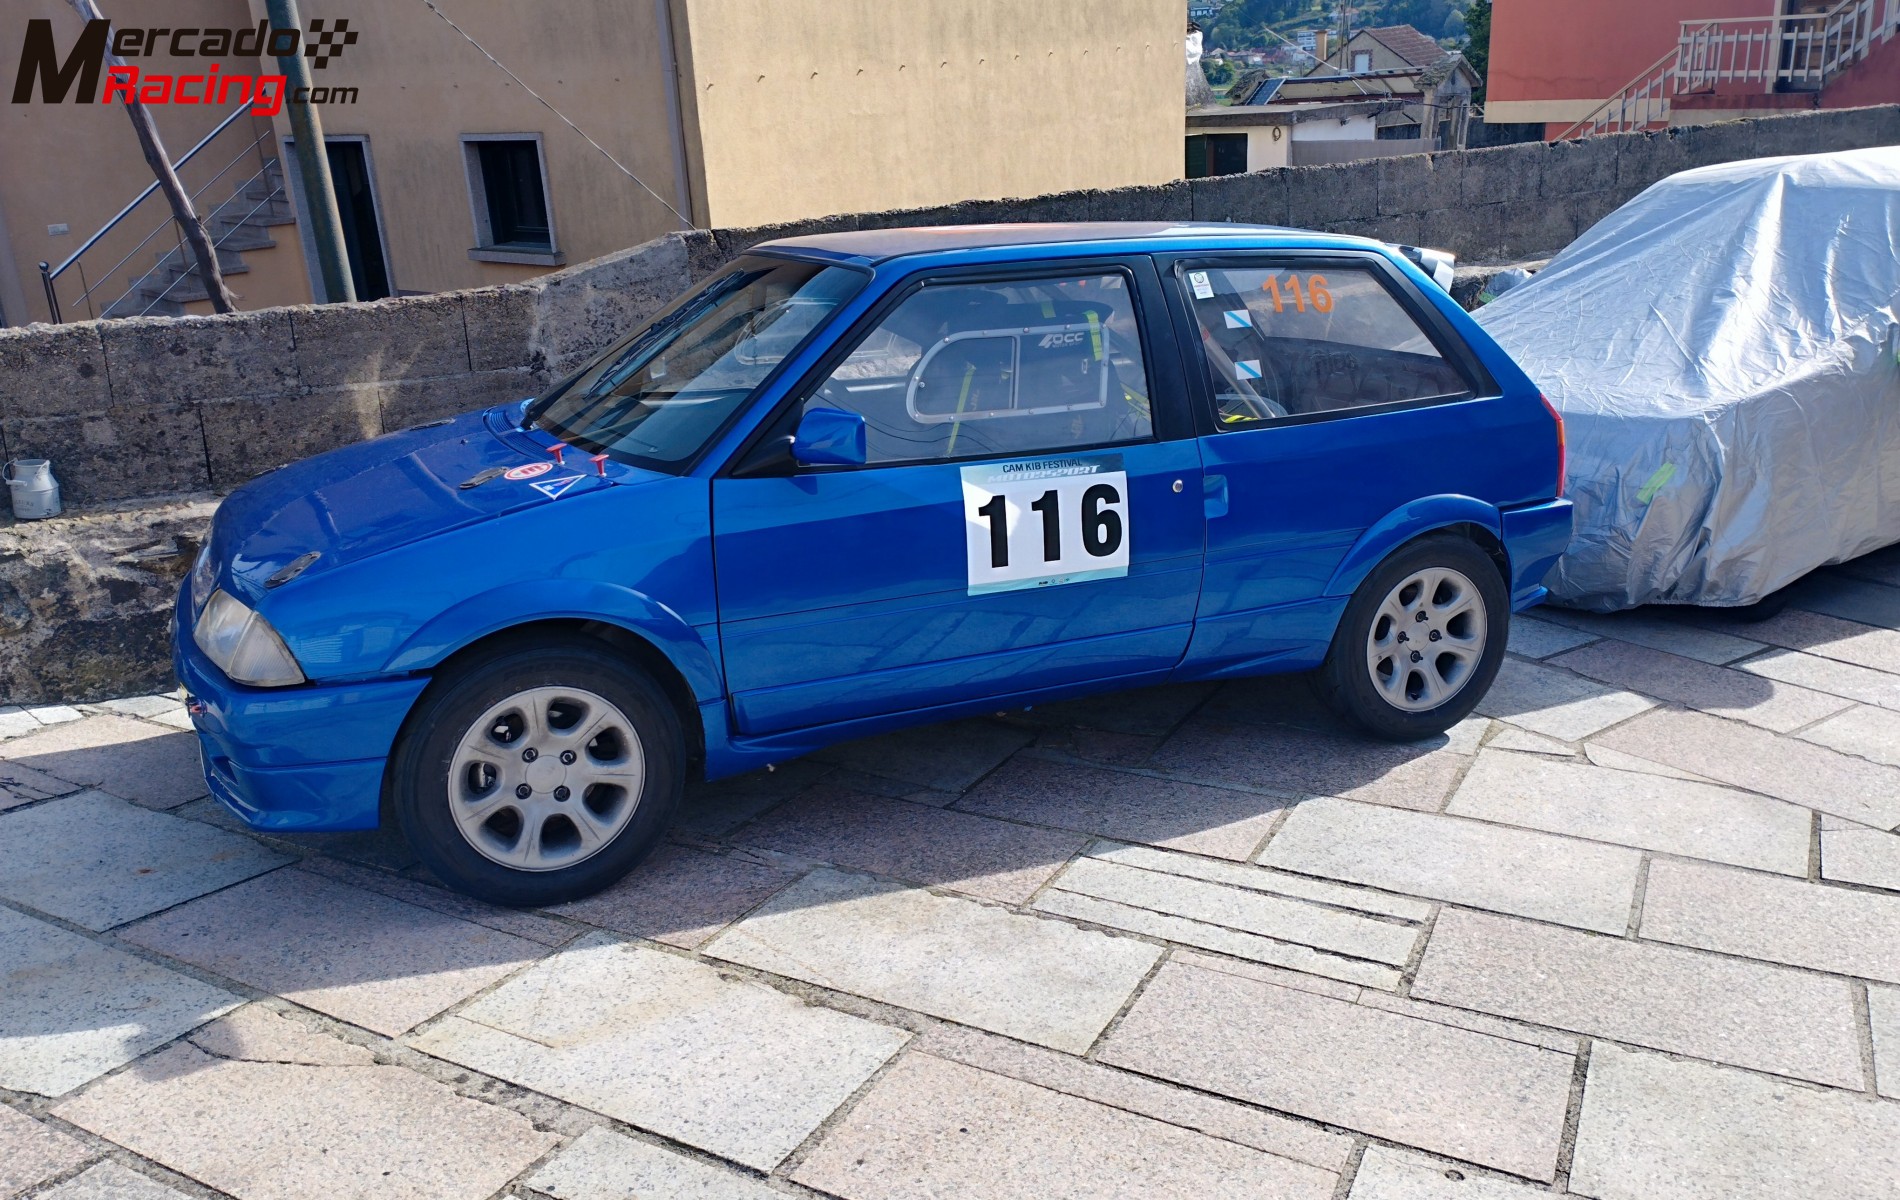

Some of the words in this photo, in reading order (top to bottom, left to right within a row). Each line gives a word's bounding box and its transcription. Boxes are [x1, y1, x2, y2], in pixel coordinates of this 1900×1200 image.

[1262, 273, 1334, 314] 116
[988, 464, 1101, 482] MOTORSPORT
[1002, 462, 1024, 474] CAM
[1025, 461, 1042, 472] KIB
[1043, 458, 1083, 471] FESTIVAL
[978, 483, 1123, 569] 116
